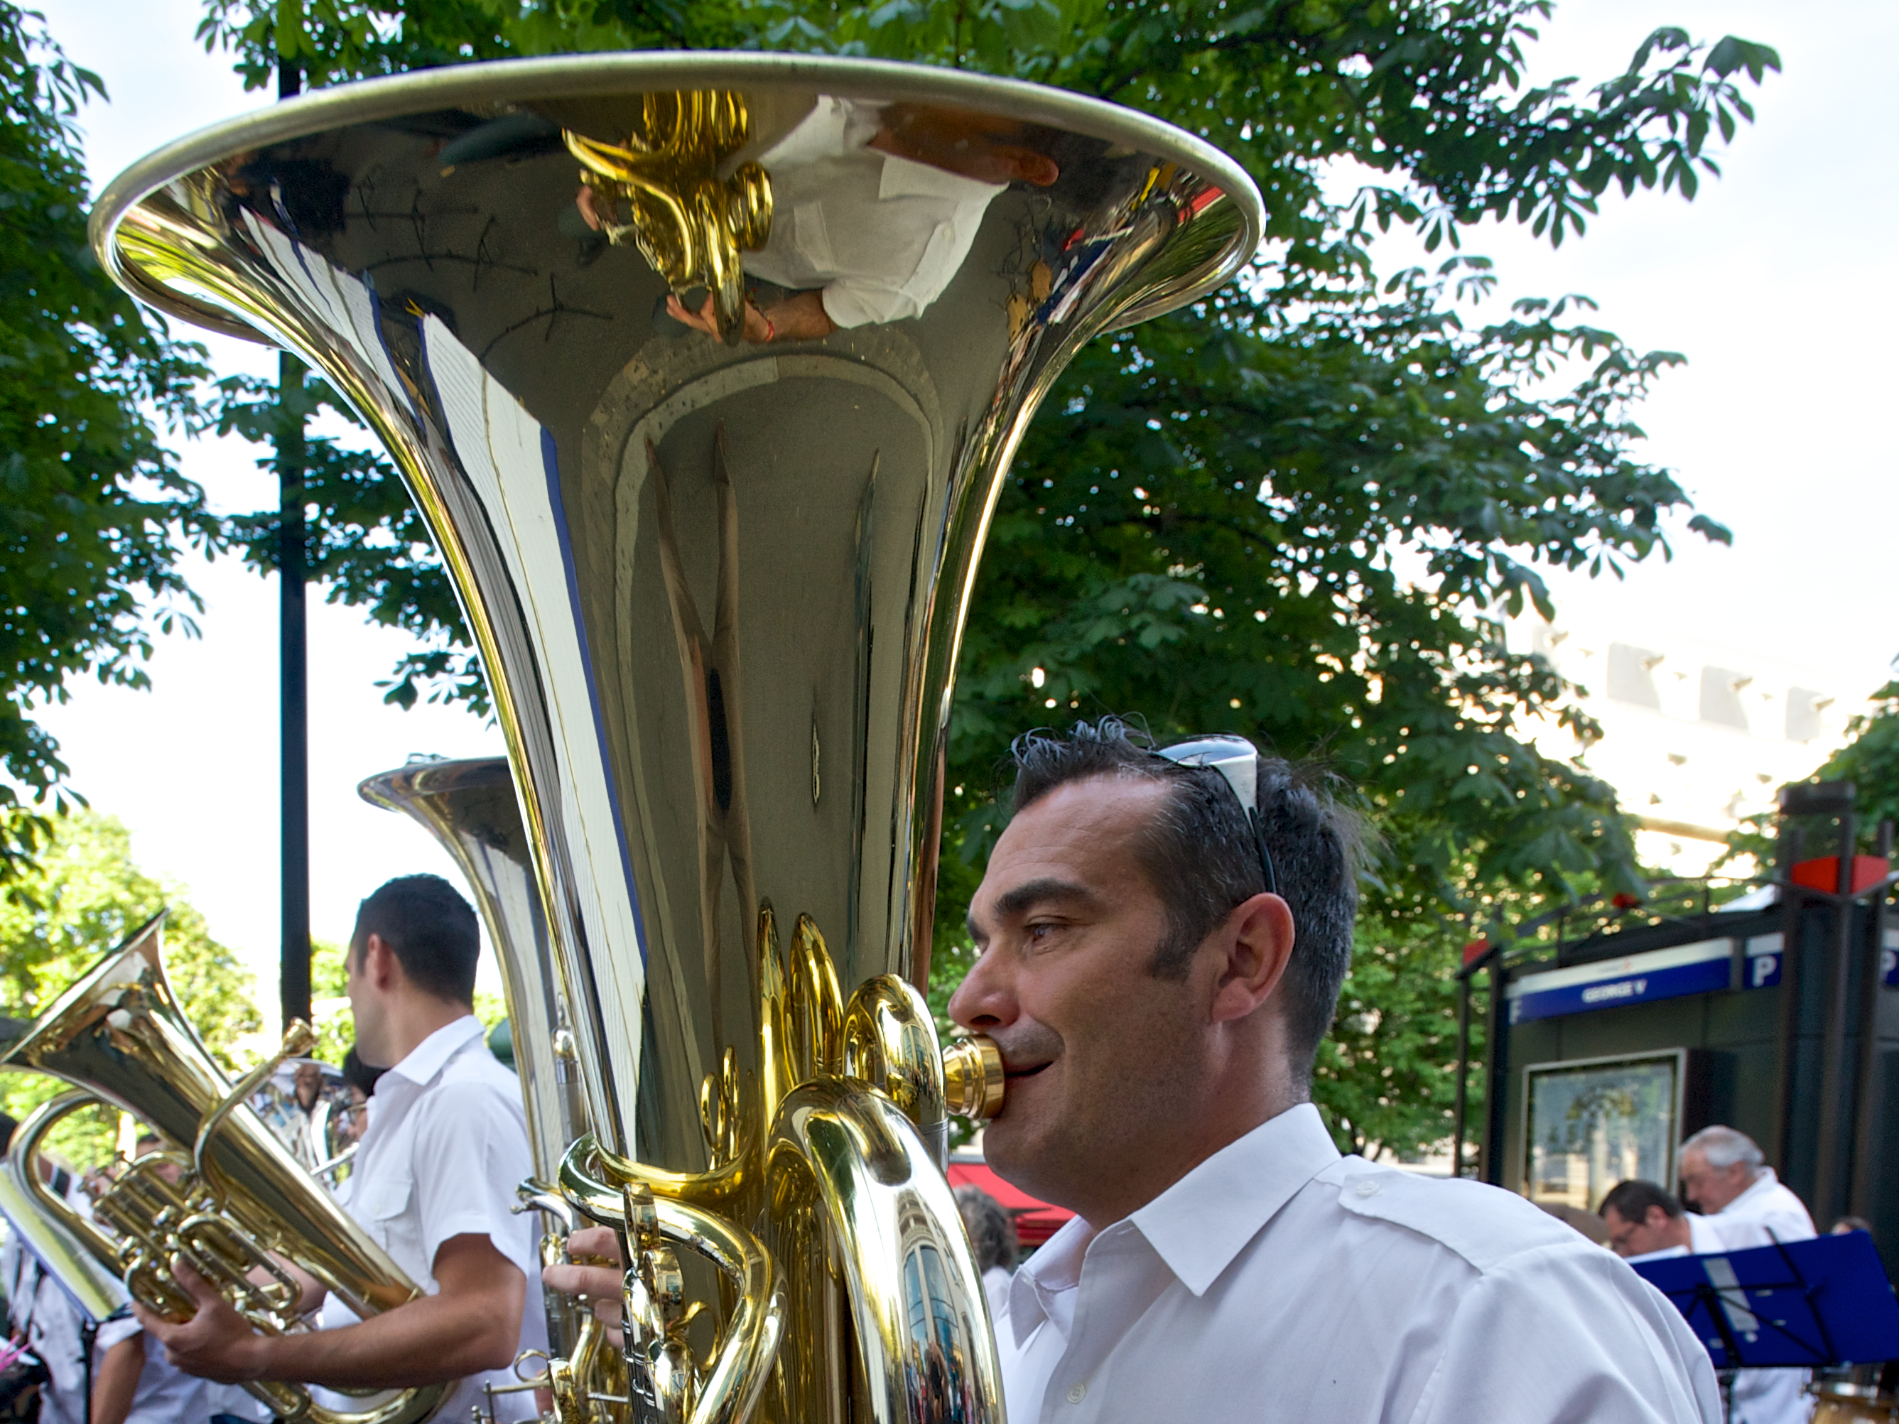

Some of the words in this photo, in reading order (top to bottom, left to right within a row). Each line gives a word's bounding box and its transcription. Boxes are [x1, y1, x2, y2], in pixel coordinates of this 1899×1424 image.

[1752, 953, 1777, 987] P
[1581, 981, 1633, 1003] GEORGE
[1634, 979, 1648, 995] V
